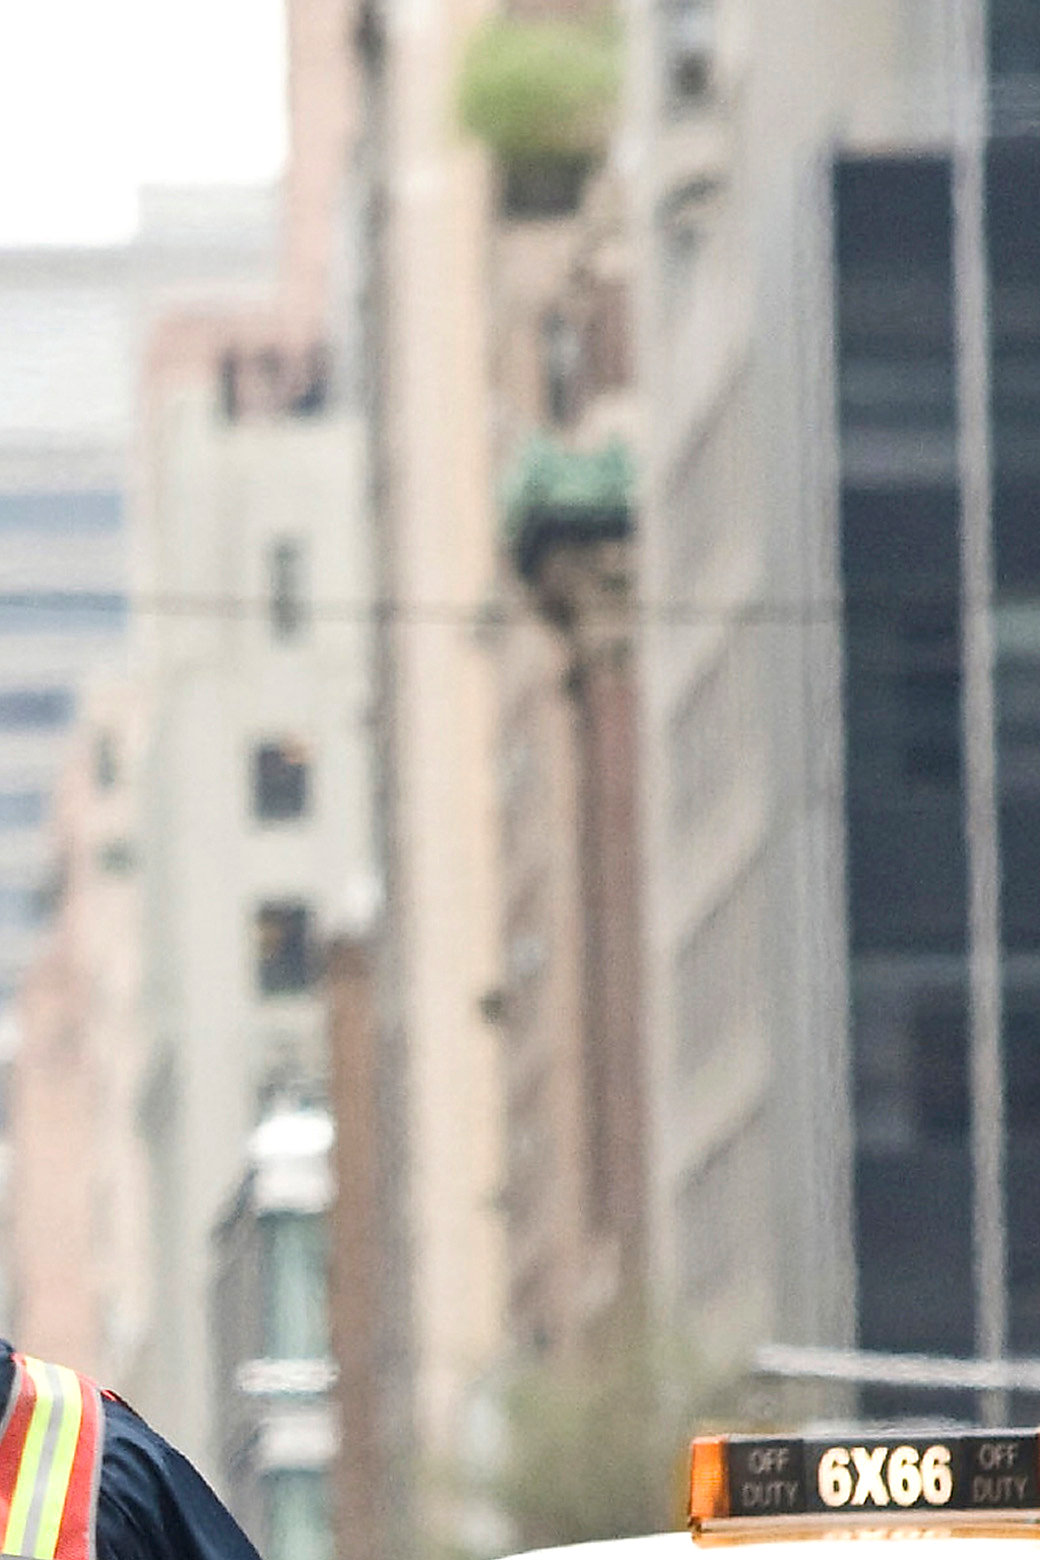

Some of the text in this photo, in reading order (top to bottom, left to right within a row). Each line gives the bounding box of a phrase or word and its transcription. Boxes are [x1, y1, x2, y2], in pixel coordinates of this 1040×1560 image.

[748, 1447, 790, 1474] OFF
[979, 1443, 1019, 1470] OFF
[818, 1444, 953, 1507] 6X66
[973, 1475, 1029, 1503] DUTY
[741, 1480, 799, 1507] DUTY
